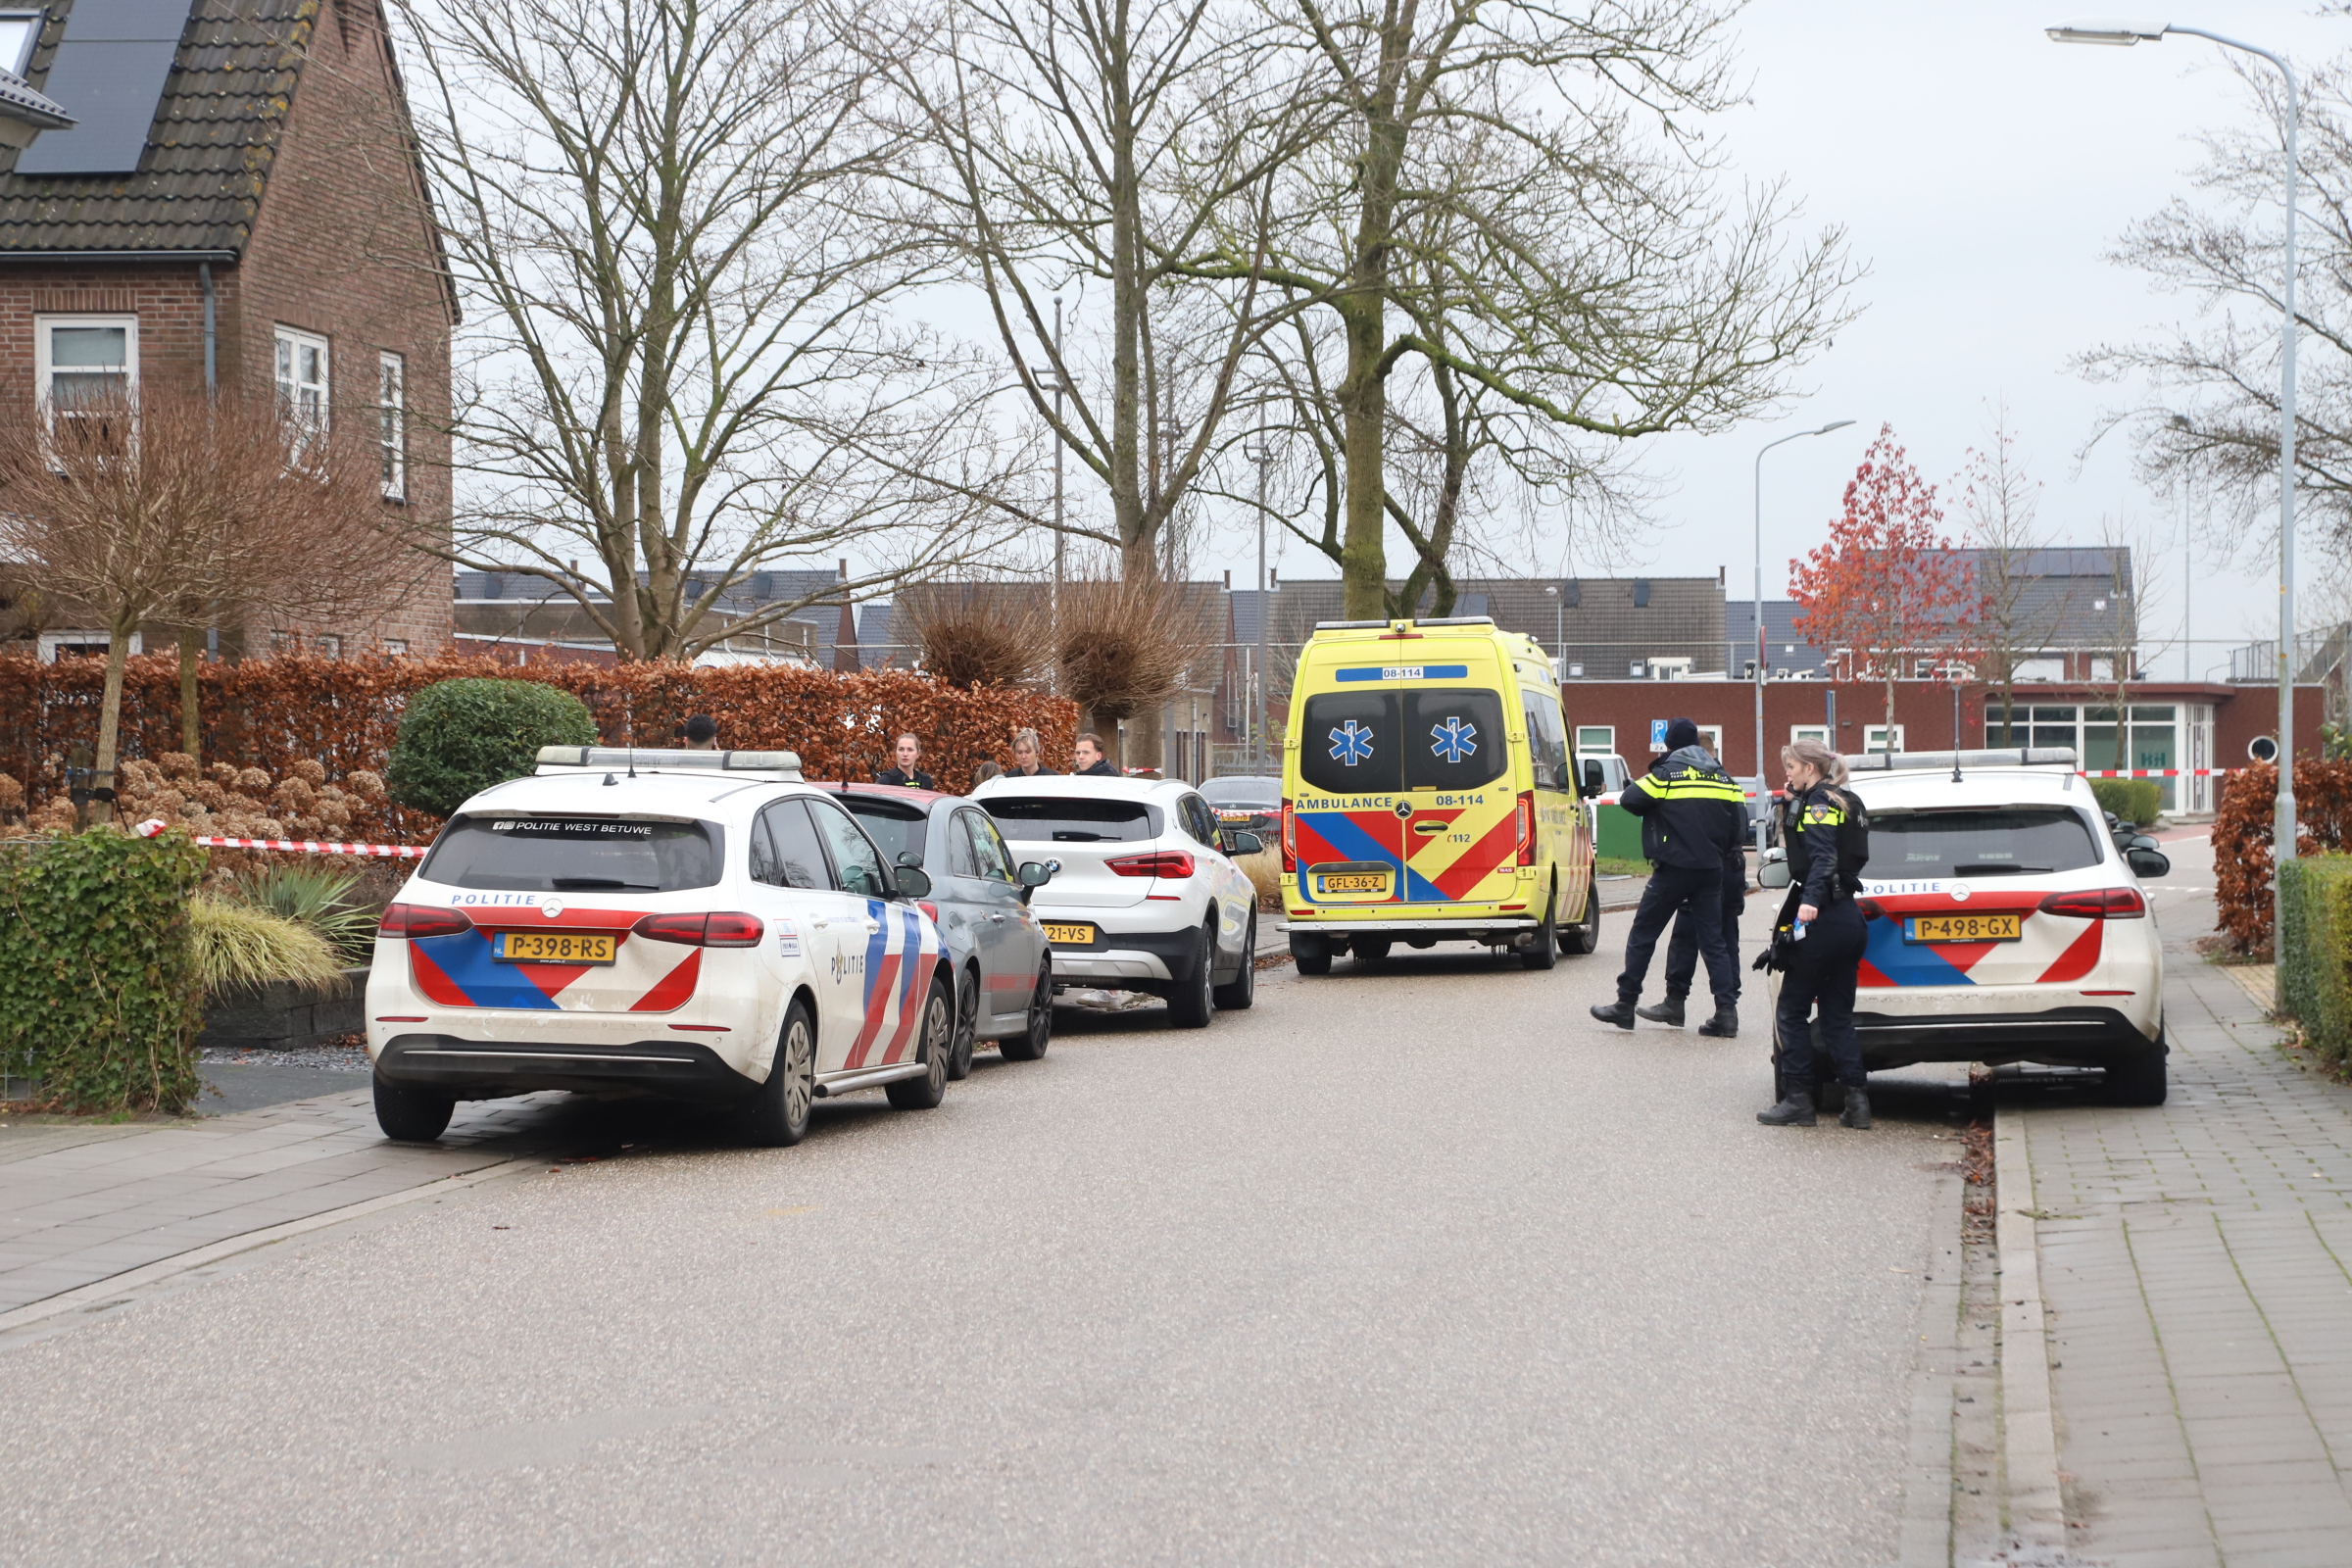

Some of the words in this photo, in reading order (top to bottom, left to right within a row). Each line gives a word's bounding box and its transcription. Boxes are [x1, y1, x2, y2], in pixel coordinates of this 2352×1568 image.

[1384, 668, 1421, 678] 08-114
[1655, 721, 1664, 734] P
[1296, 797, 1393, 810] AMBULANCE
[1436, 795, 1484, 806] 08-114
[516, 821, 562, 831] POLITIE
[564, 823, 600, 833] WEST
[600, 824, 653, 835] BETUWE
[1328, 877, 1379, 889] GFL-36-Z
[1860, 882, 1941, 896] POLITIE
[451, 894, 537, 906] POLITIE
[1043, 926, 1086, 941] 21-VS
[1921, 918, 2014, 937] P-498-GX
[513, 937, 608, 957] P-398-RS
[831, 953, 863, 985] POLITIE
